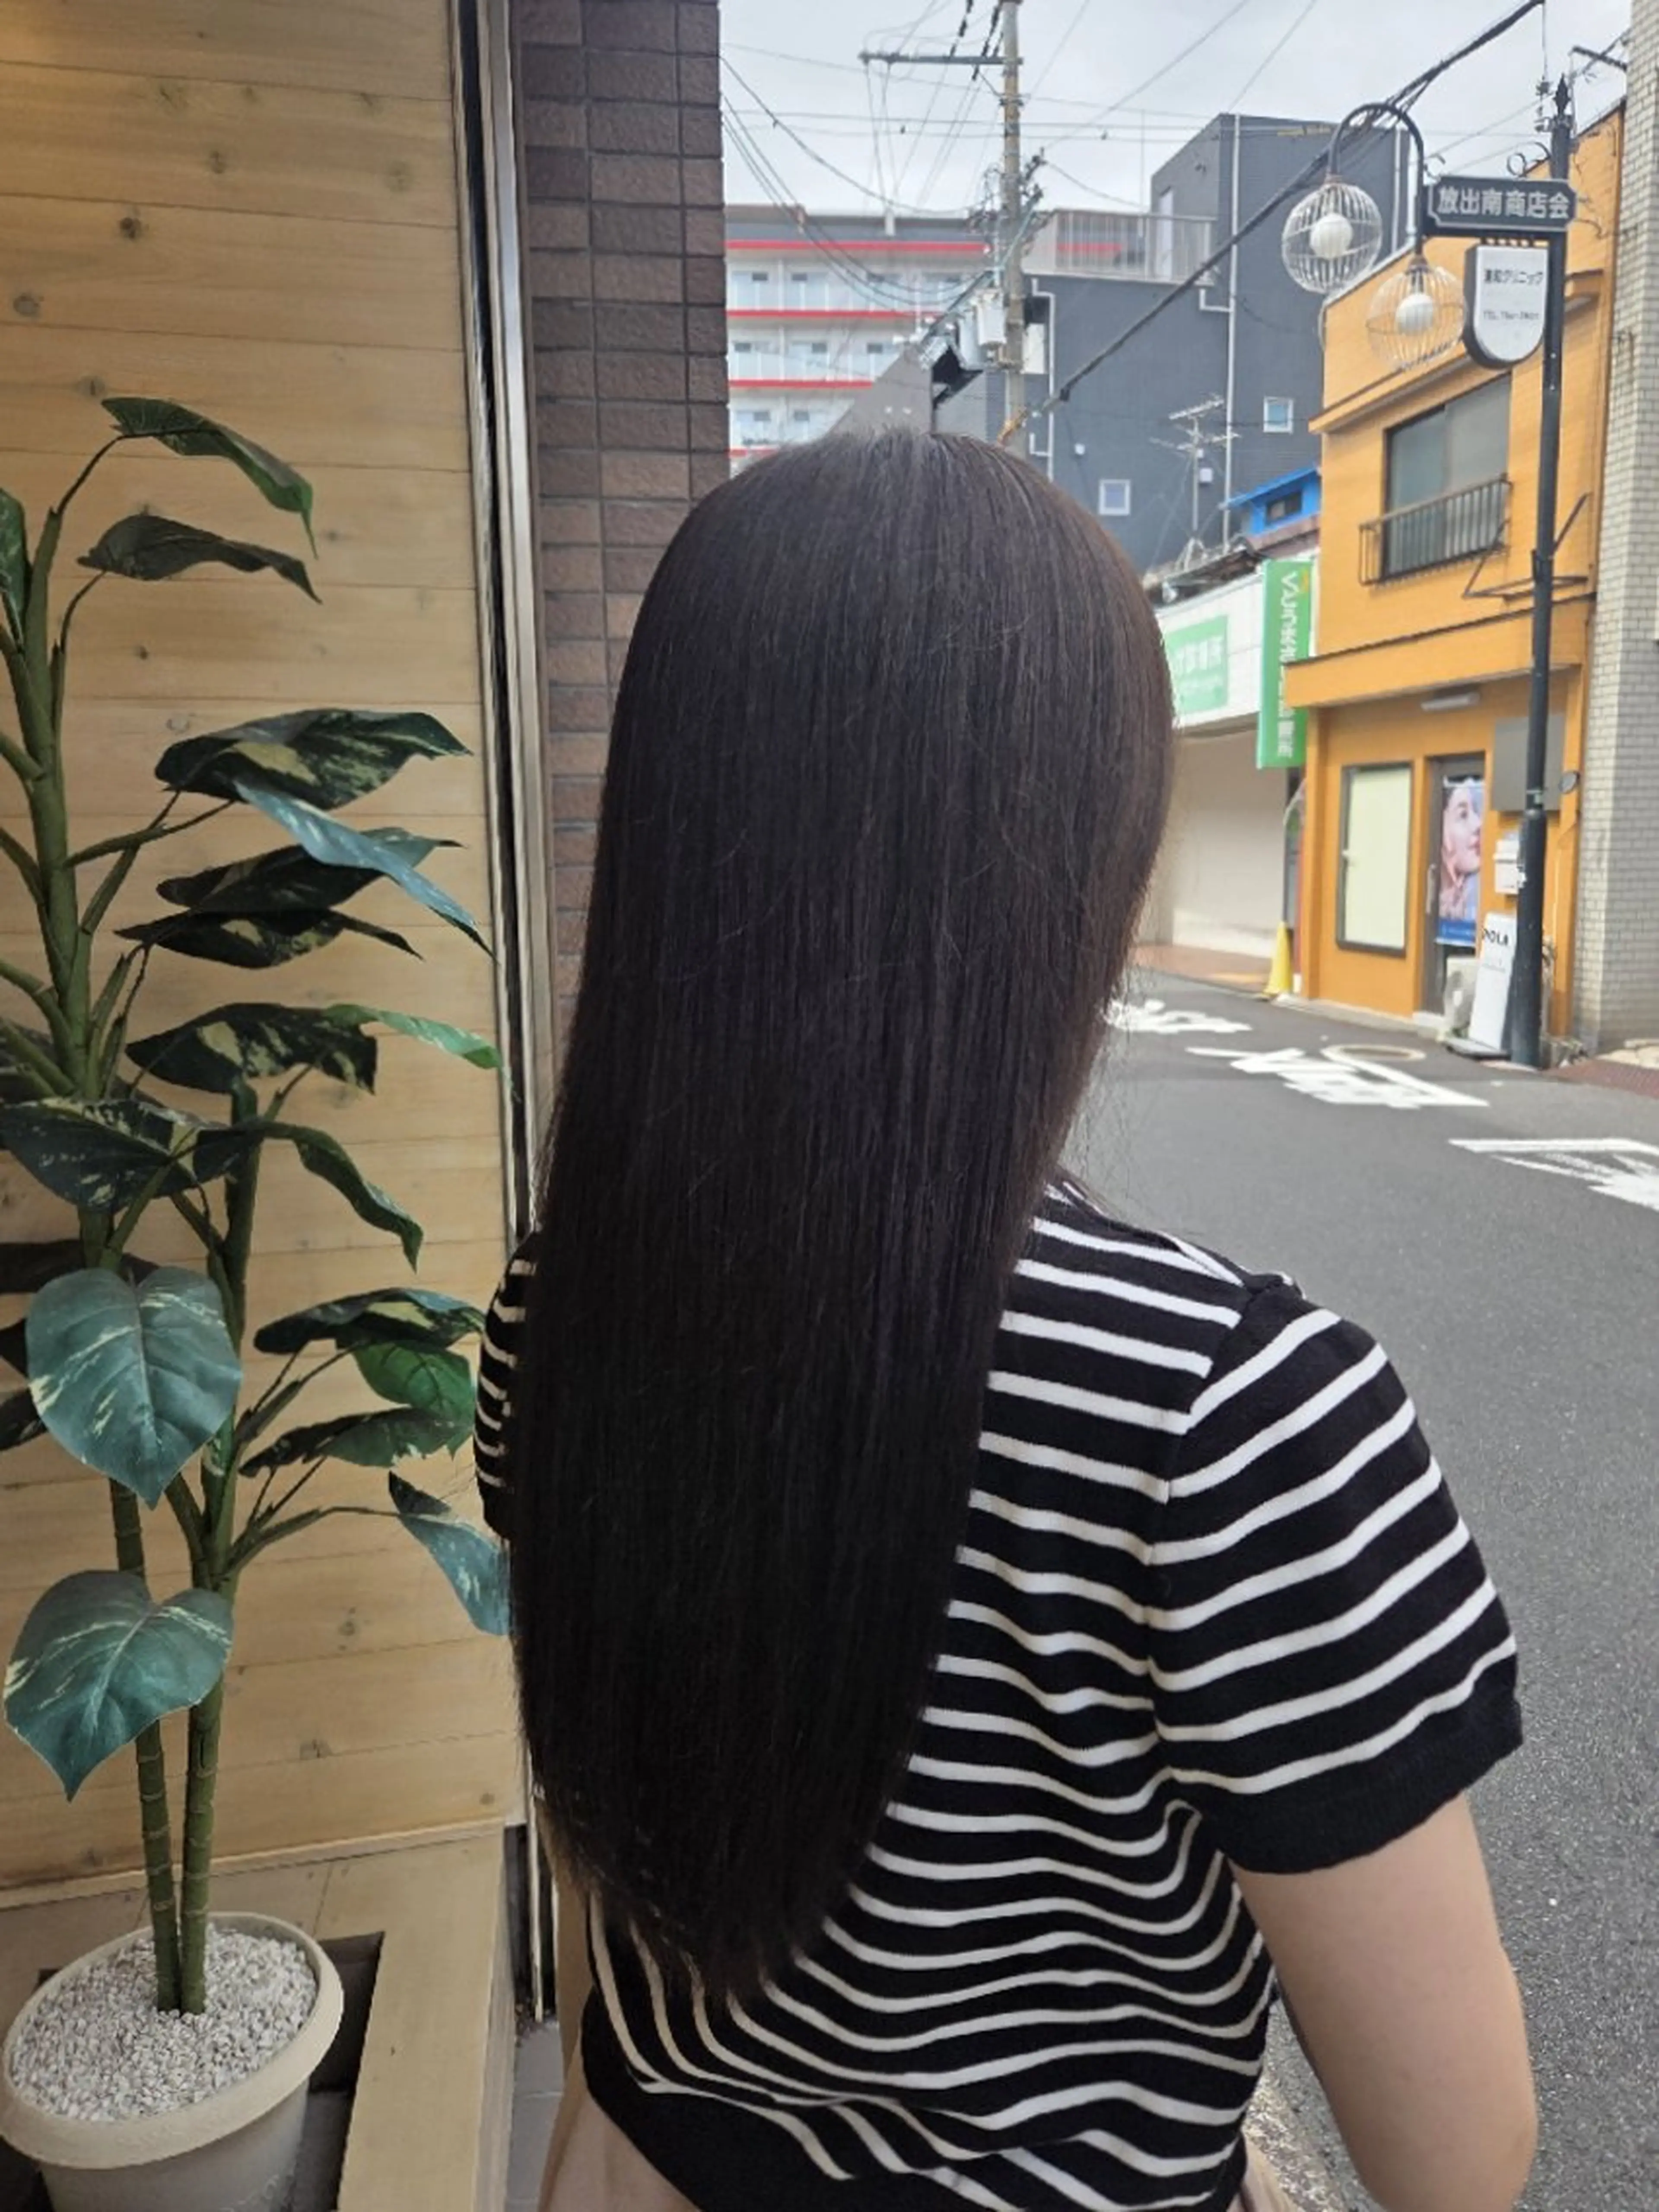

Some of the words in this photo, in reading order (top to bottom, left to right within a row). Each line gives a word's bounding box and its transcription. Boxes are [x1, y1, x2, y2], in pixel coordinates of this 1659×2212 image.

[1437, 186, 1570, 218] 放出南商店会
